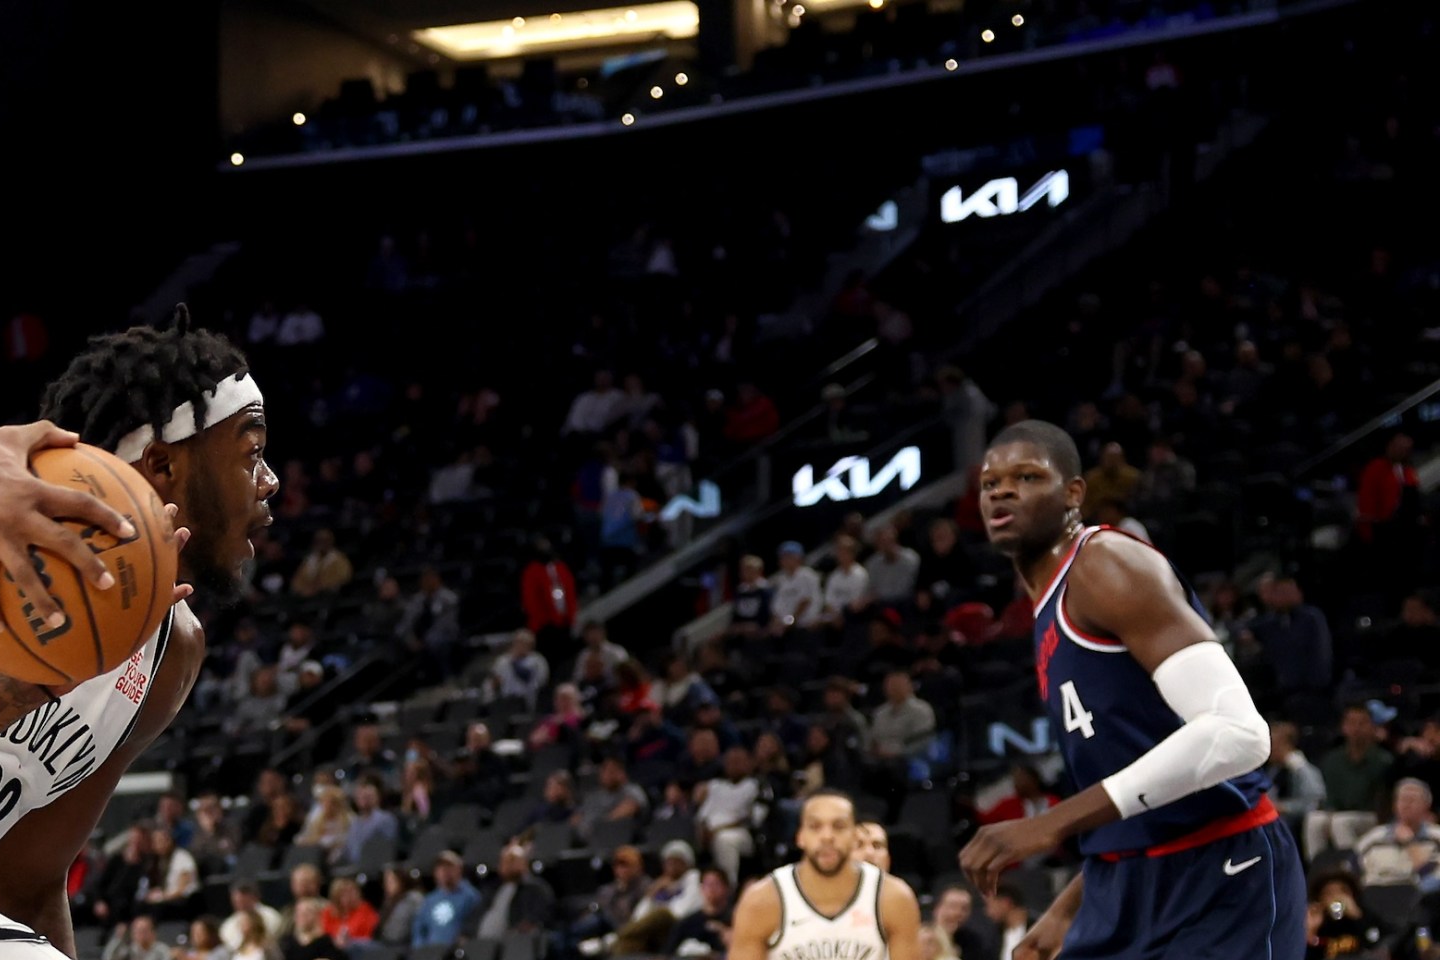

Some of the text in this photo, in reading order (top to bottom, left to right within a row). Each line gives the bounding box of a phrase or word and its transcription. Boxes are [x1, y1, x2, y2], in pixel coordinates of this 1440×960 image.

[941, 169, 1069, 223] KIA
[792, 446, 921, 507] KIA
[115, 676, 144, 705] GUIDE
[124, 661, 146, 690] YOUR
[1059, 680, 1095, 739] 4
[0, 697, 96, 797] OOKLYN
